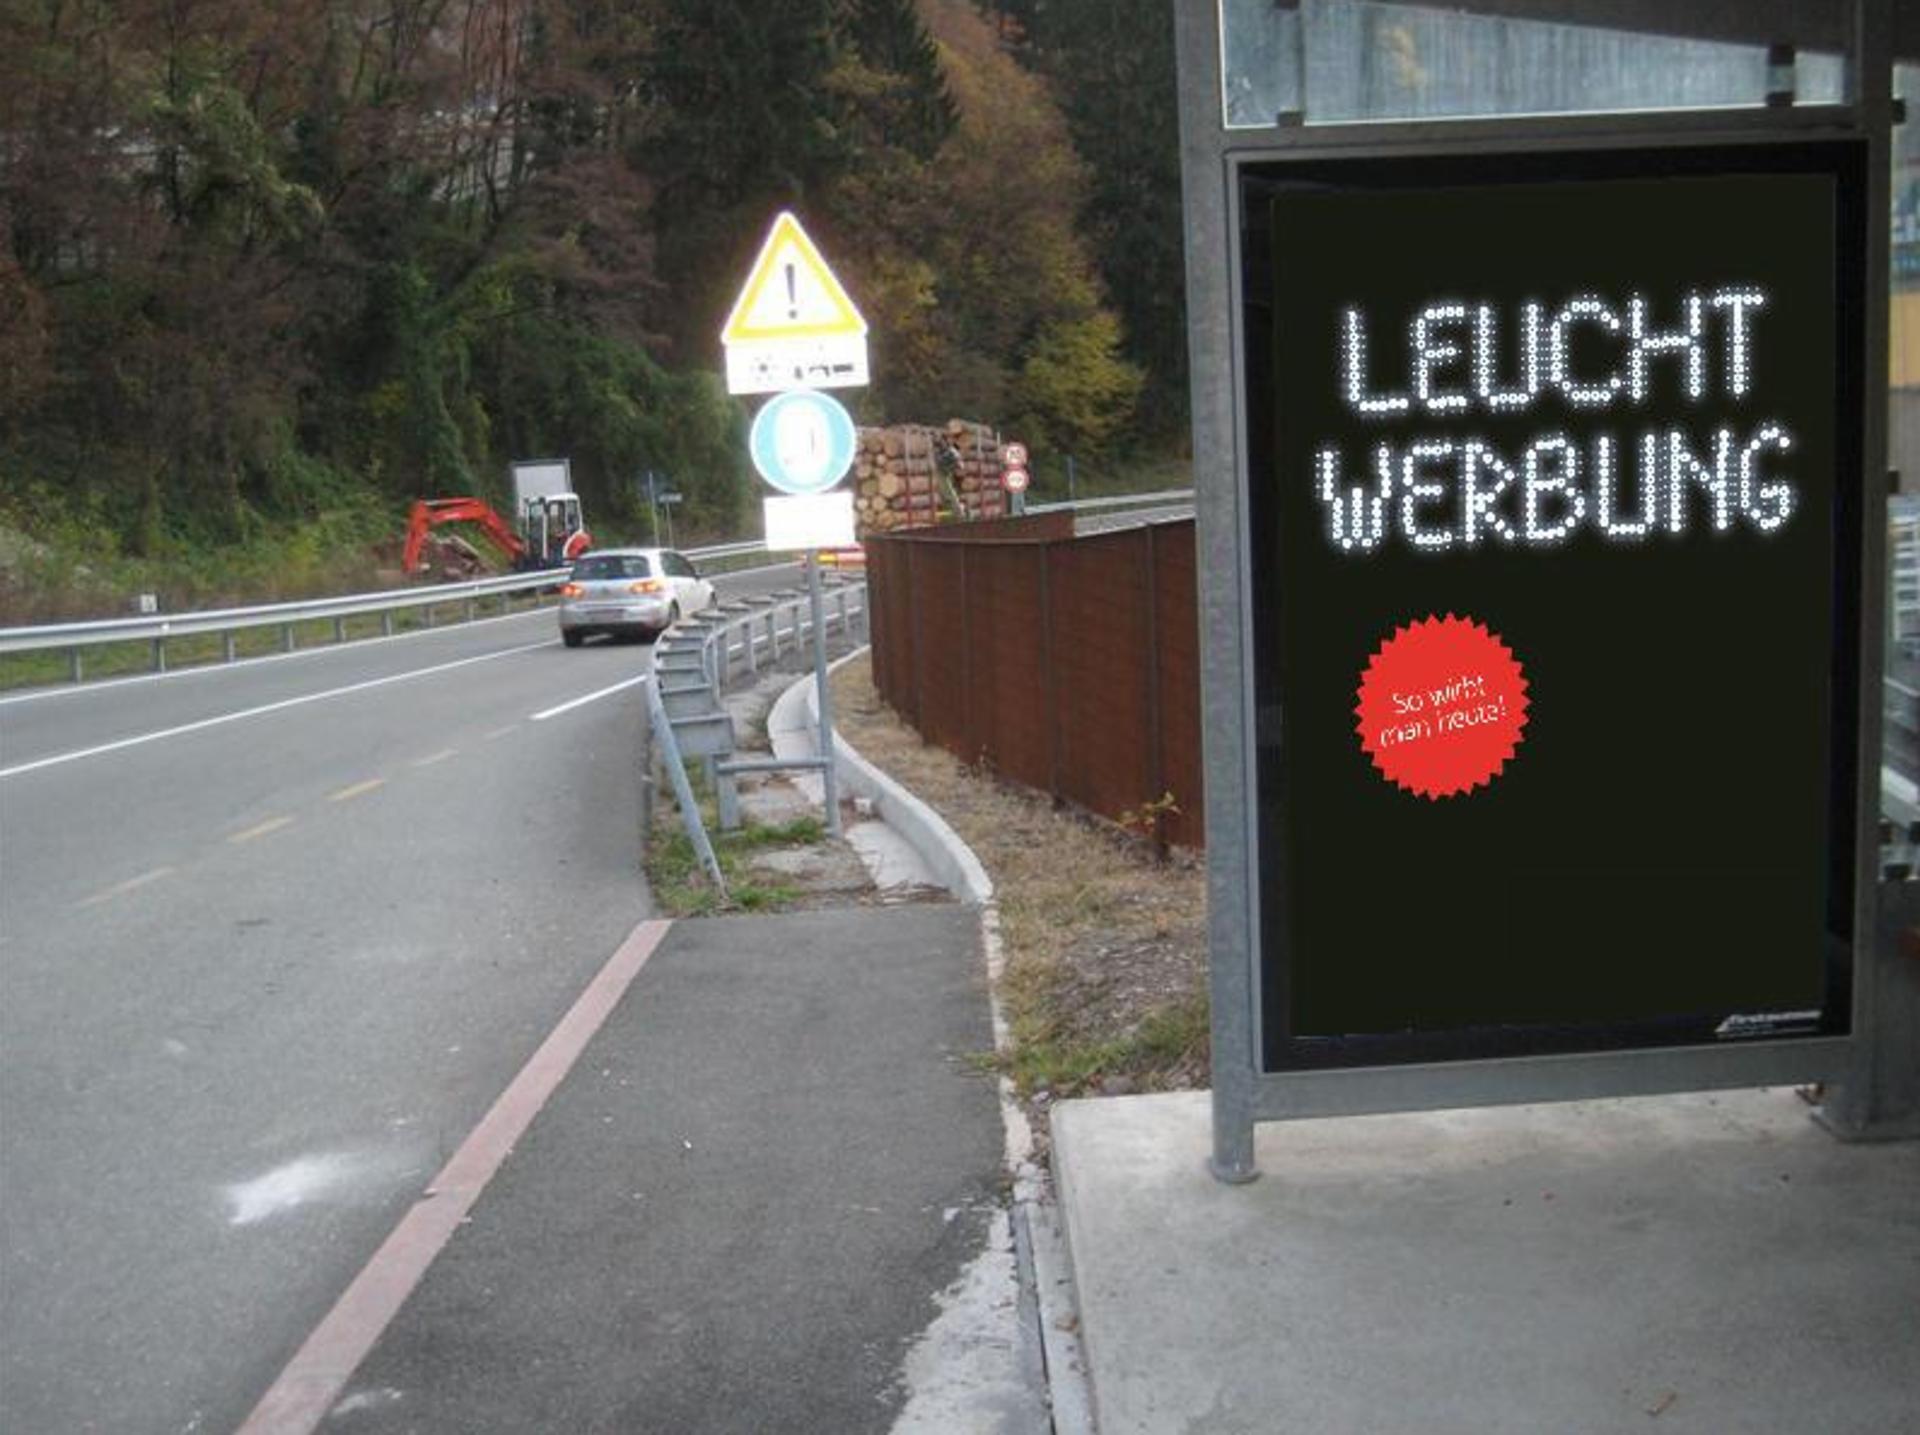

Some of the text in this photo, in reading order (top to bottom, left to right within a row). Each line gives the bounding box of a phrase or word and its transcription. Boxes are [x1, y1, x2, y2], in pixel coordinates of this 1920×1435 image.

[1341, 288, 1766, 411] LEUCHT
[1315, 424, 1797, 552] WERBUNG
[1380, 695, 1507, 749] man heute!
[1392, 692, 1424, 715] So
